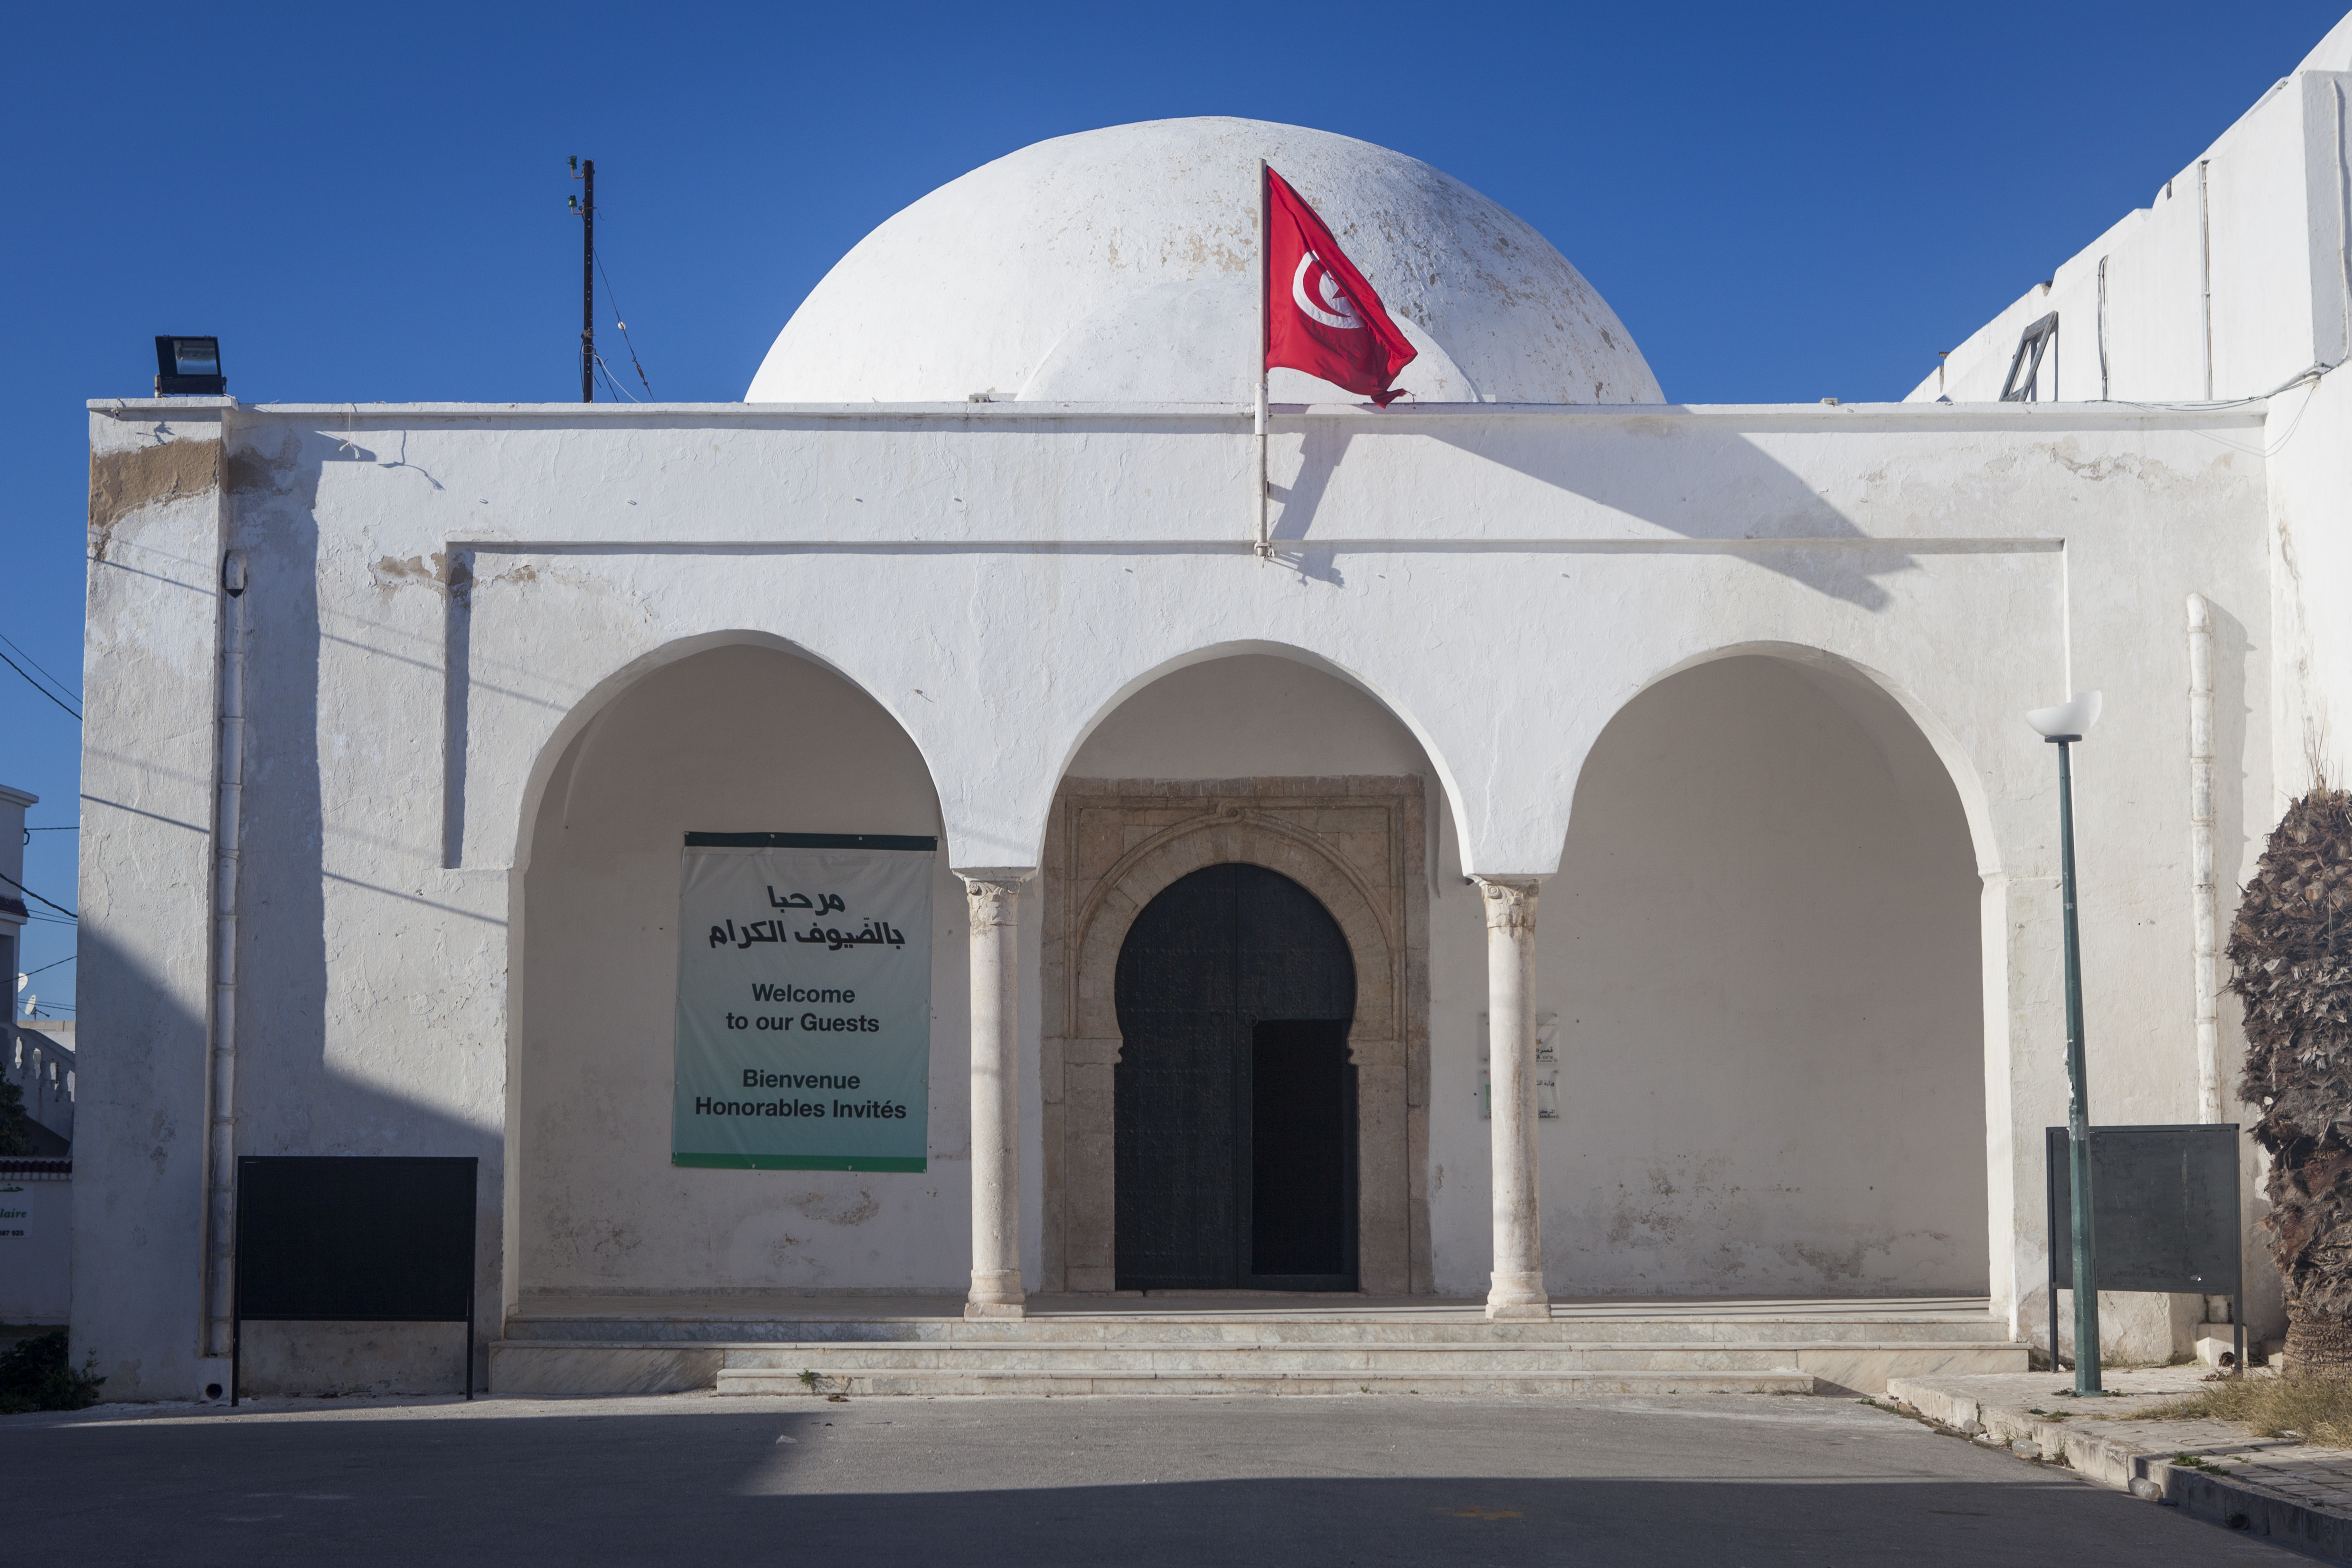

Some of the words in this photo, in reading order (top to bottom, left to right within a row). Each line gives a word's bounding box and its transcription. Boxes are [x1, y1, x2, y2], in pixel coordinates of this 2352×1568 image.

[767, 885, 846, 916] مرحبا
[709, 919, 787, 949] الكرام
[751, 983, 856, 1004] Welcome
[725, 1012, 749, 1030] to
[755, 1016, 794, 1031] our
[800, 1012, 880, 1033] Guests
[743, 1069, 861, 1090] Bienvenue
[696, 1097, 826, 1117] Honorables
[833, 1099, 907, 1119] Invités
